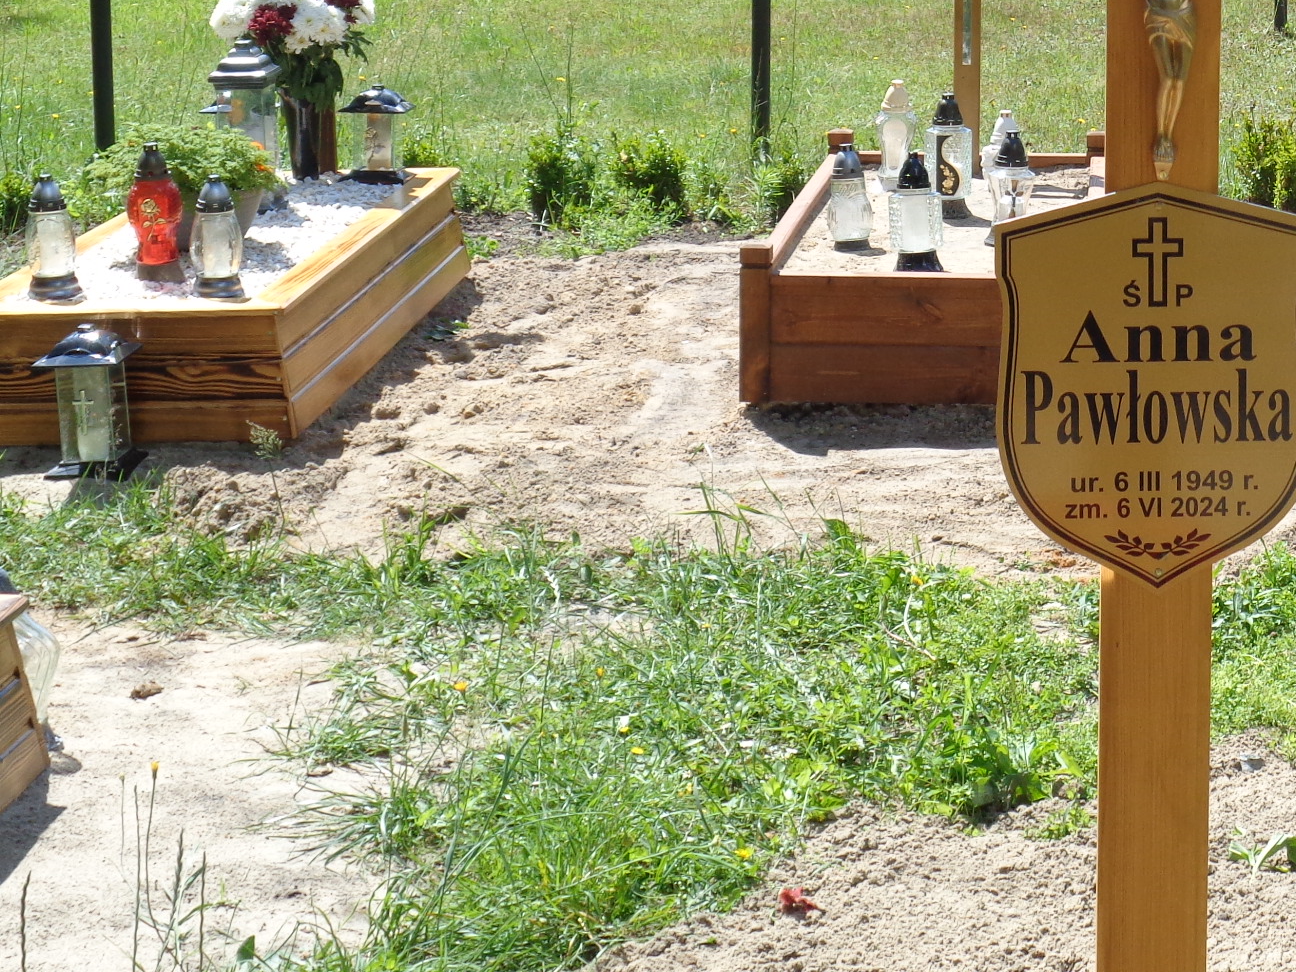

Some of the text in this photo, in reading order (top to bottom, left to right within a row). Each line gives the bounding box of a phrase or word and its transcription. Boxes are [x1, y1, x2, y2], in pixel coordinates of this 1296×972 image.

[1123, 279, 1193, 307] Ś P
[1059, 309, 1257, 363] Anna
[1020, 368, 1293, 445] Pawłowska
[1070, 469, 1259, 493] ur. 6 III 1949 r.
[1064, 496, 1251, 519] zm. 6 VI 2024 r.
